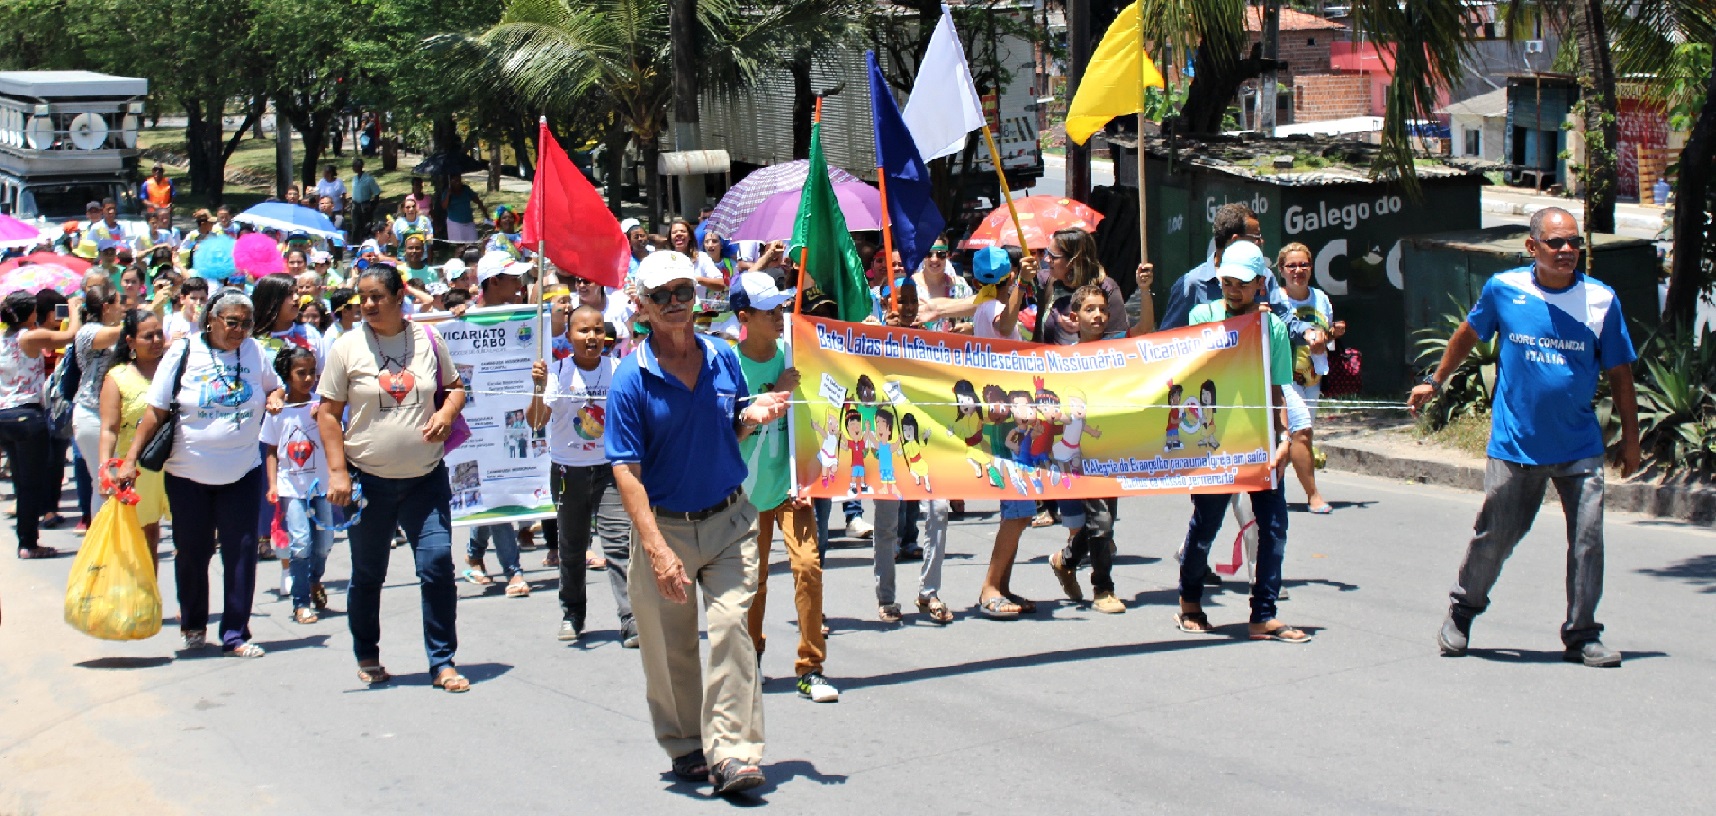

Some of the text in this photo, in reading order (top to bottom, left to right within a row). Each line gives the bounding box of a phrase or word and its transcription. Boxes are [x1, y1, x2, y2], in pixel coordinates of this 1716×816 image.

[1284, 196, 1401, 235] Galego do
[473, 338, 506, 350] CABO
[816, 323, 845, 351] Bate
[847, 328, 881, 357] Latas
[884, 332, 900, 358] da
[902, 335, 950, 364] Infância
[953, 350, 962, 366] e
[964, 341, 1046, 372] Adolescência
[1045, 349, 1126, 373] Missionária
[1538, 337, 1585, 352] COMANDA
